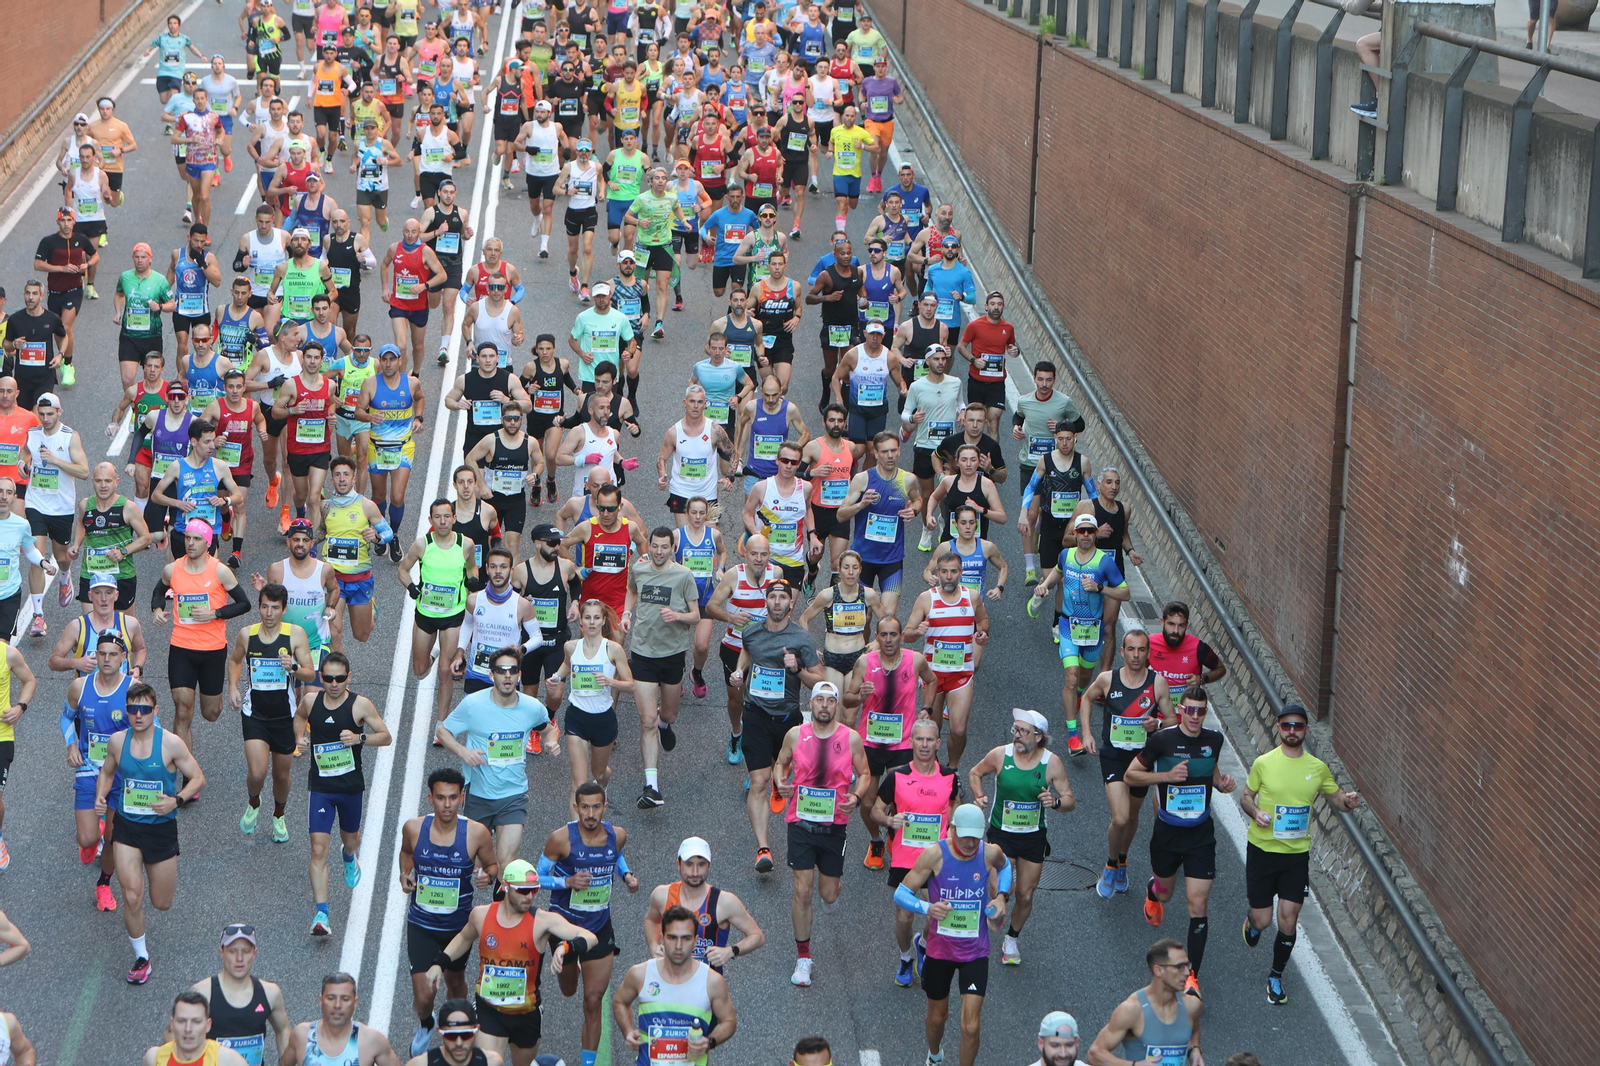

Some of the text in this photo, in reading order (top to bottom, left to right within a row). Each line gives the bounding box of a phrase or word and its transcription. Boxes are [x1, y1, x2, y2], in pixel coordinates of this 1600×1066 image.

[296, 597, 318, 606] GILETE
[642, 594, 669, 602] SAYSKY
[486, 622, 512, 632] CALIFATO
[326, 744, 346, 752] ZURICH
[940, 886, 985, 900] FILÍPIDES
[496, 958, 536, 968] CAMAS
[234, 1038, 258, 1047] ZURICH
